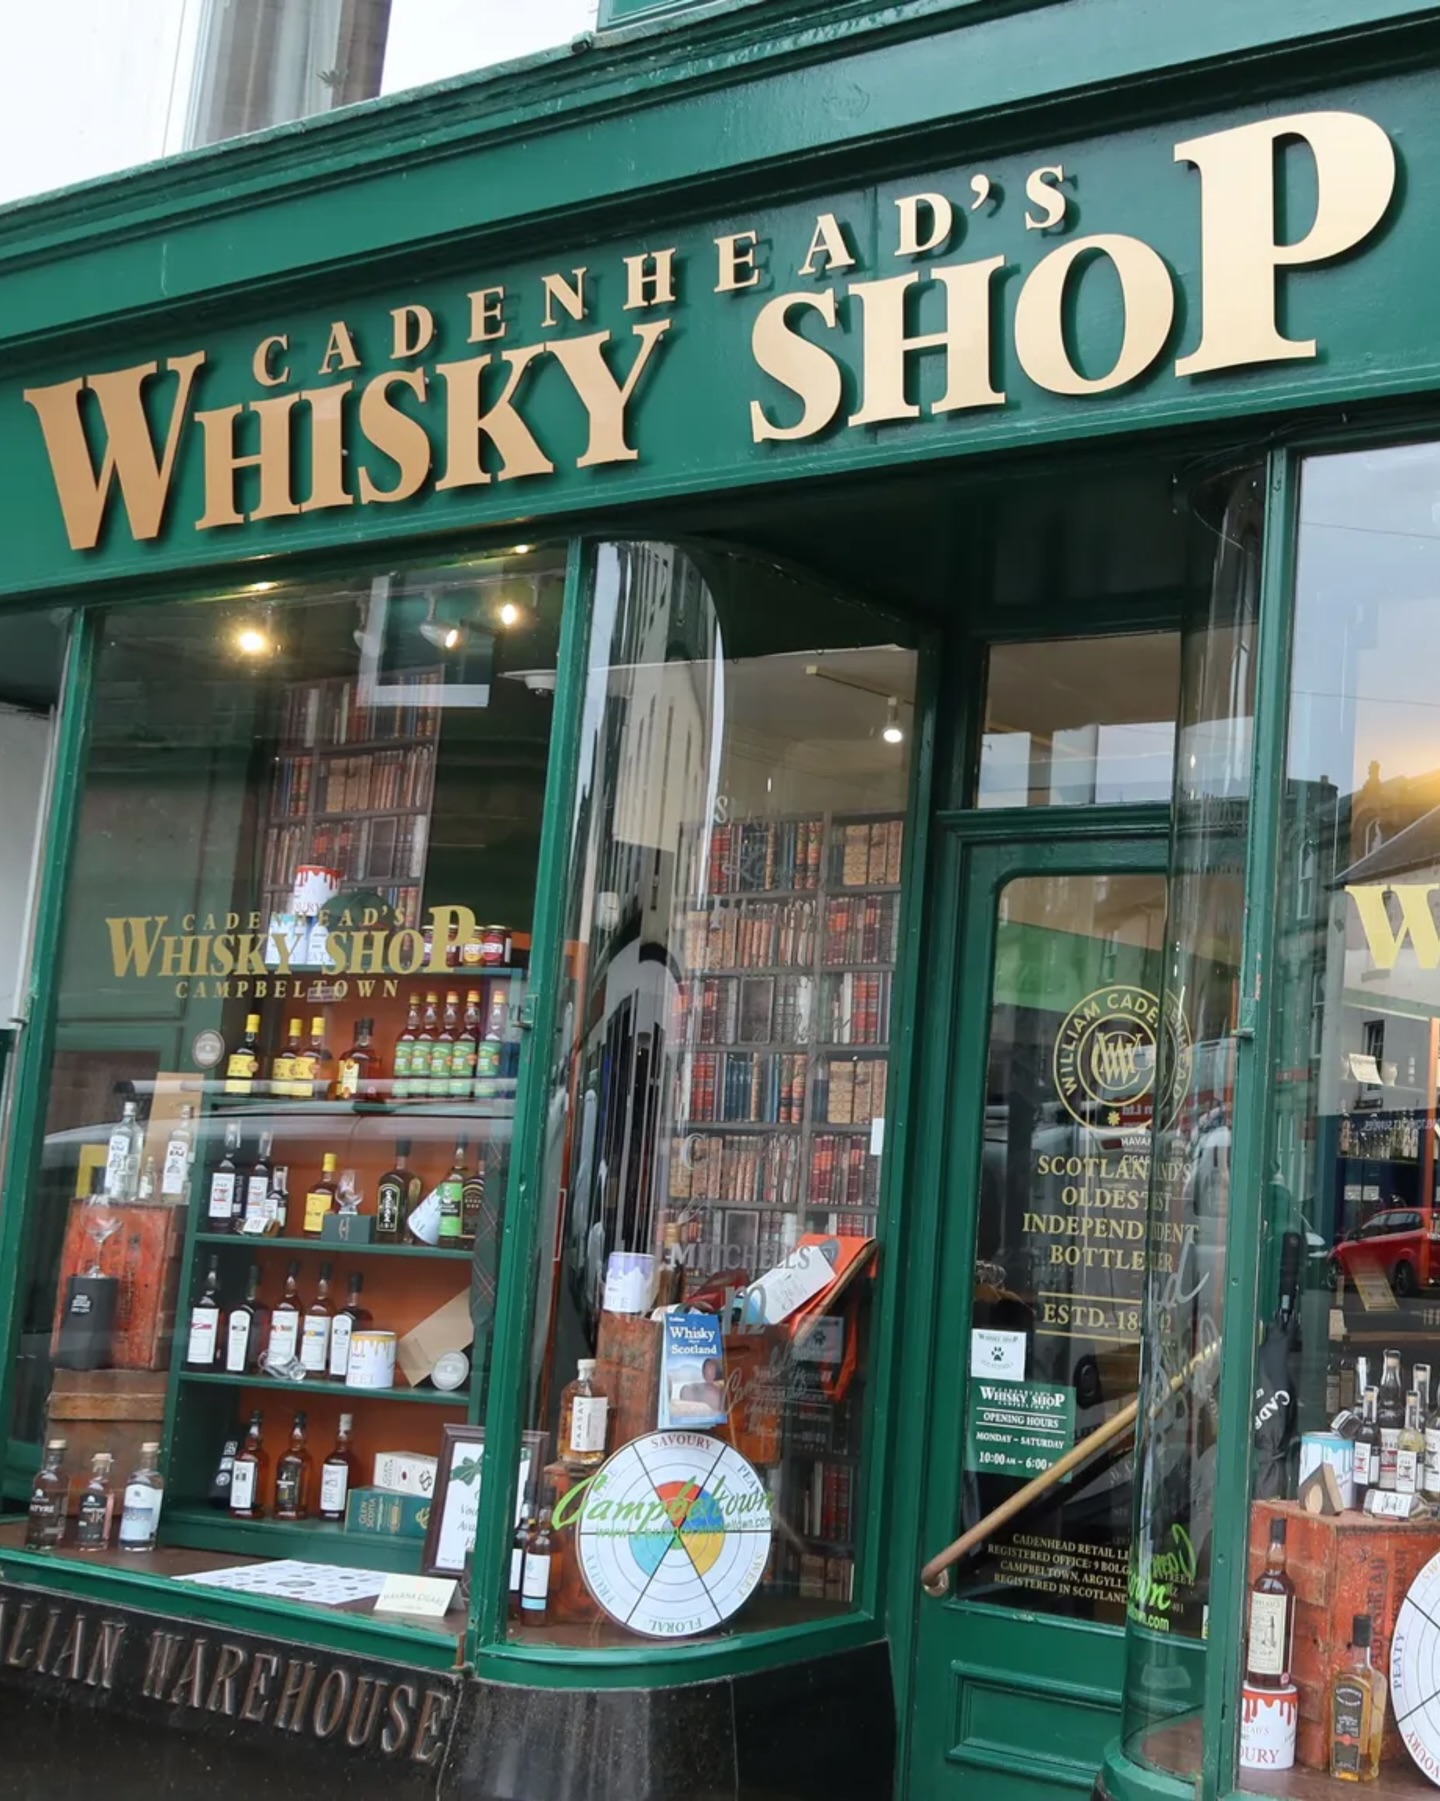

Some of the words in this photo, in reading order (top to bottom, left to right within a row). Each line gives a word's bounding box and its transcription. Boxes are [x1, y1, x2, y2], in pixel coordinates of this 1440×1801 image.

[252, 165, 1066, 387] CADENHEAD'S
[23, 319, 672, 551] WHISKY
[750, 111, 1396, 443] SHOP
[182, 905, 406, 931] CADENHEAD'S
[105, 915, 306, 978] WHISKY
[321, 905, 476, 976] SHOP
[175, 979, 400, 999] CAMPBELTOWN
[1060, 1001, 1100, 1096] WILLIAM
[669, 1326, 715, 1342] Whisky
[671, 1344, 717, 1355] Scotland
[979, 1385, 1028, 1404] WHISKY
[1031, 1393, 1065, 1408] SHOP
[983, 1412, 1025, 1425] OPENING
[1026, 1416, 1059, 1429] HOURS
[651, 1435, 714, 1450] SAVOURY
[976, 1431, 1012, 1443] MONDAY
[1020, 1436, 1065, 1450] SATURDAY
[979, 1451, 1006, 1464] 10:00
[1025, 1457, 1048, 1470] 6:00
[988, 1543, 1050, 1563] REGISTERED
[1012, 1533, 1076, 1552] CADENHEAD
[1077, 1544, 1115, 1558] RETAIL
[737, 1553, 764, 1599] SWEET
[1000, 1560, 1080, 1584] CAMPBELTOWN,
[994, 1573, 1057, 1593] REGISTERED
[1058, 1583, 1071, 1595] IN
[649, 1618, 703, 1633] FLORAL
[1394, 1634, 1405, 1689] PEATY
[142, 1630, 451, 1766] WAREHOUSE
